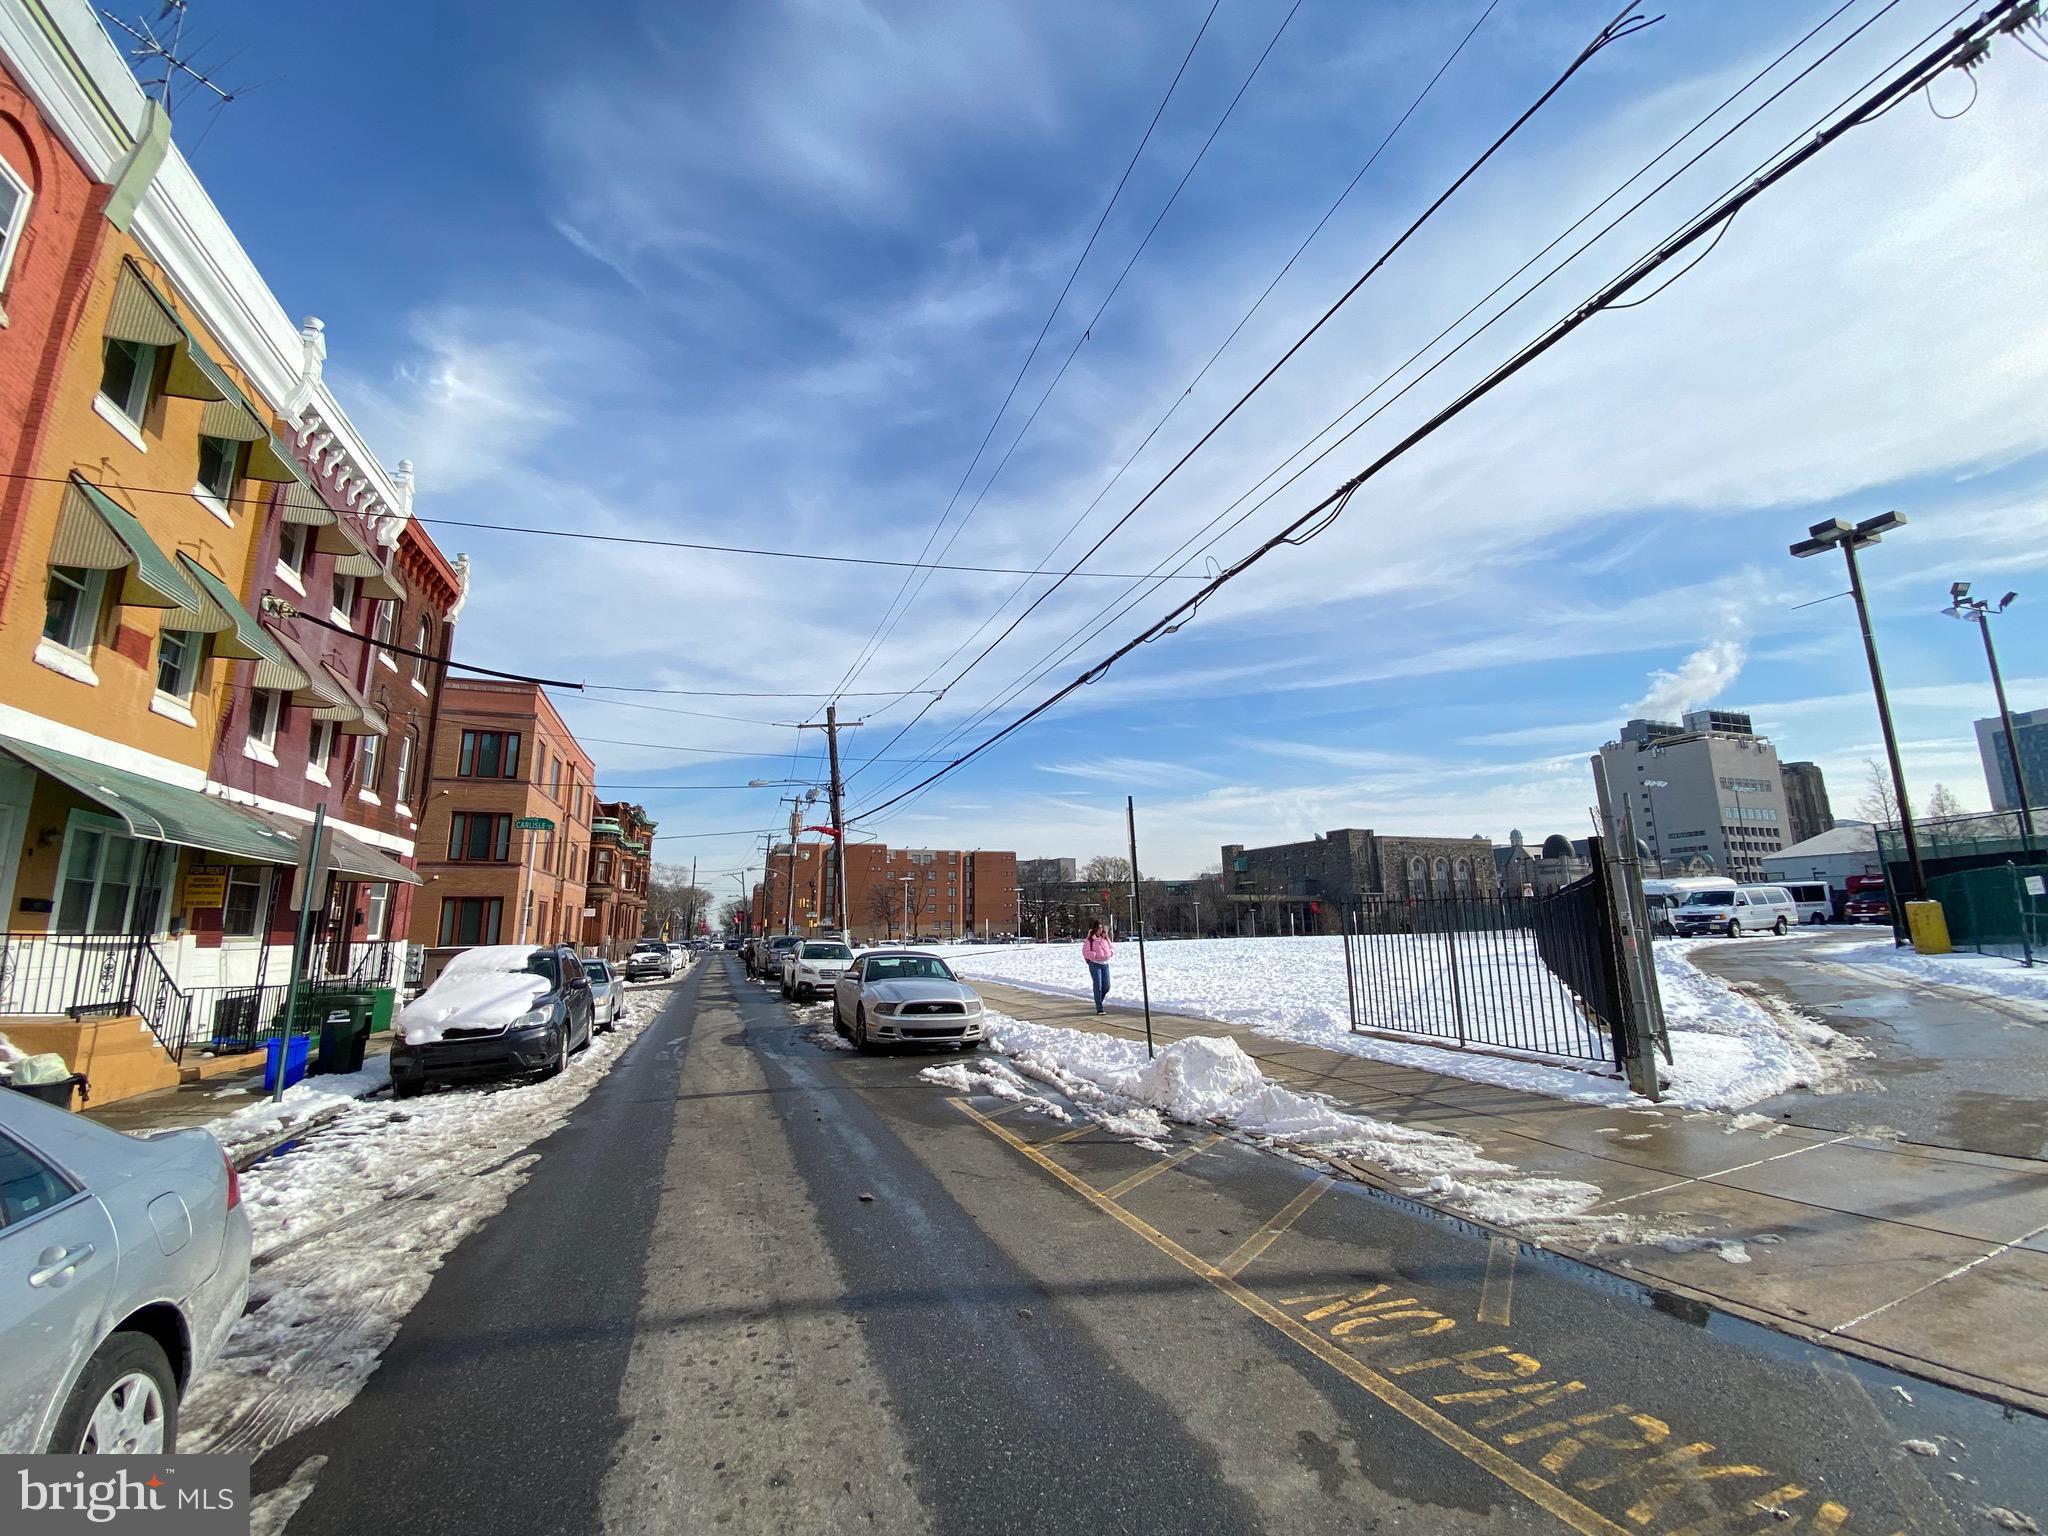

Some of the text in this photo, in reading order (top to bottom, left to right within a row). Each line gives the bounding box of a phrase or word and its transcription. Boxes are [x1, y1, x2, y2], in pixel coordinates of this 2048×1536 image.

[516, 821, 546, 829] CARLISLE
[191, 866, 225, 875] FOR RENT
[1278, 1284, 1456, 1344] NO
